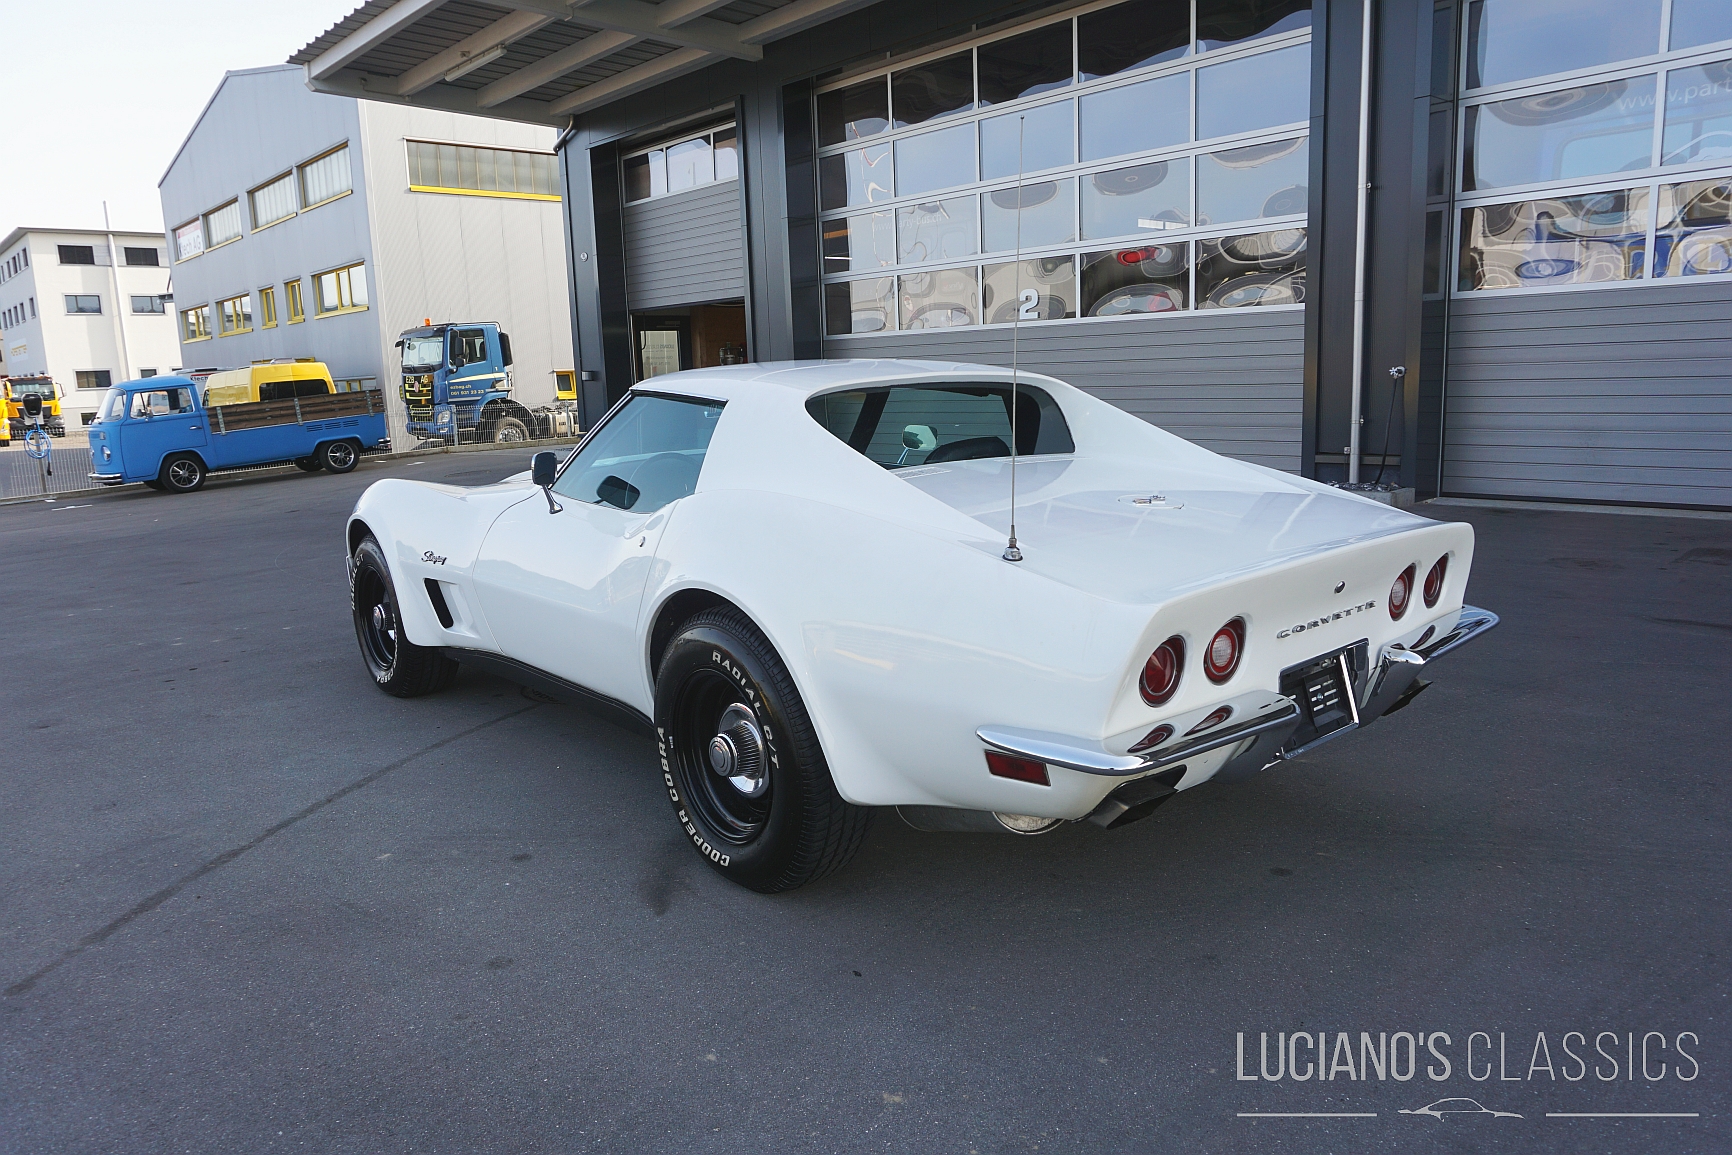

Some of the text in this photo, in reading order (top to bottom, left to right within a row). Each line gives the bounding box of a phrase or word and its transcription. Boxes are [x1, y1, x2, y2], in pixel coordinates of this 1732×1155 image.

[874, 212, 942, 231] www.arty-bus.ch
[1020, 289, 1040, 319] 2
[420, 374, 429, 383] AG
[1276, 600, 1376, 639] CORVETTE
[712, 650, 779, 769] RADIAL G/T
[657, 727, 731, 867] COOPER COBRA
